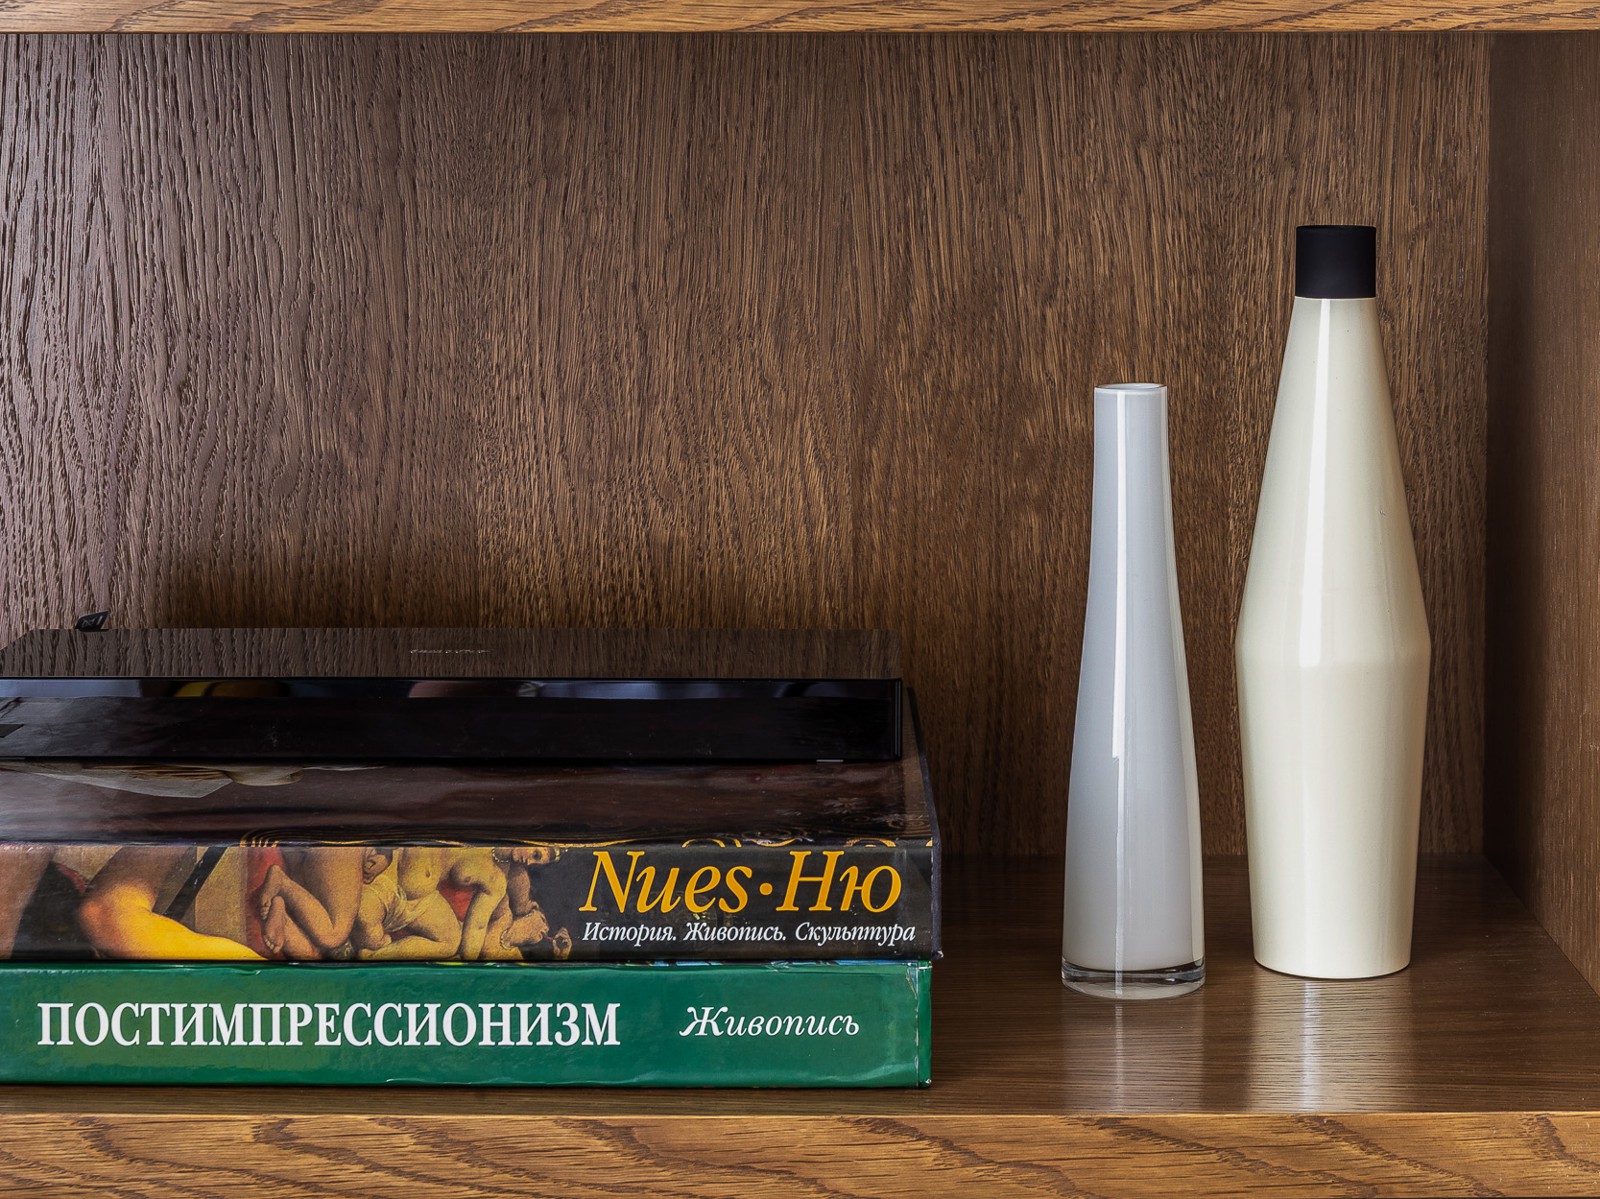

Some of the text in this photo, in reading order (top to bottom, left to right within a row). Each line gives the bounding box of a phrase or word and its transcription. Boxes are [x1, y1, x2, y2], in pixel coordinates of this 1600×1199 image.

[582, 921, 916, 947] История. Живопись. Скульптура
[37, 1001, 860, 1047] ПОСТИМПРЕССИОНИЗМ Живопись
